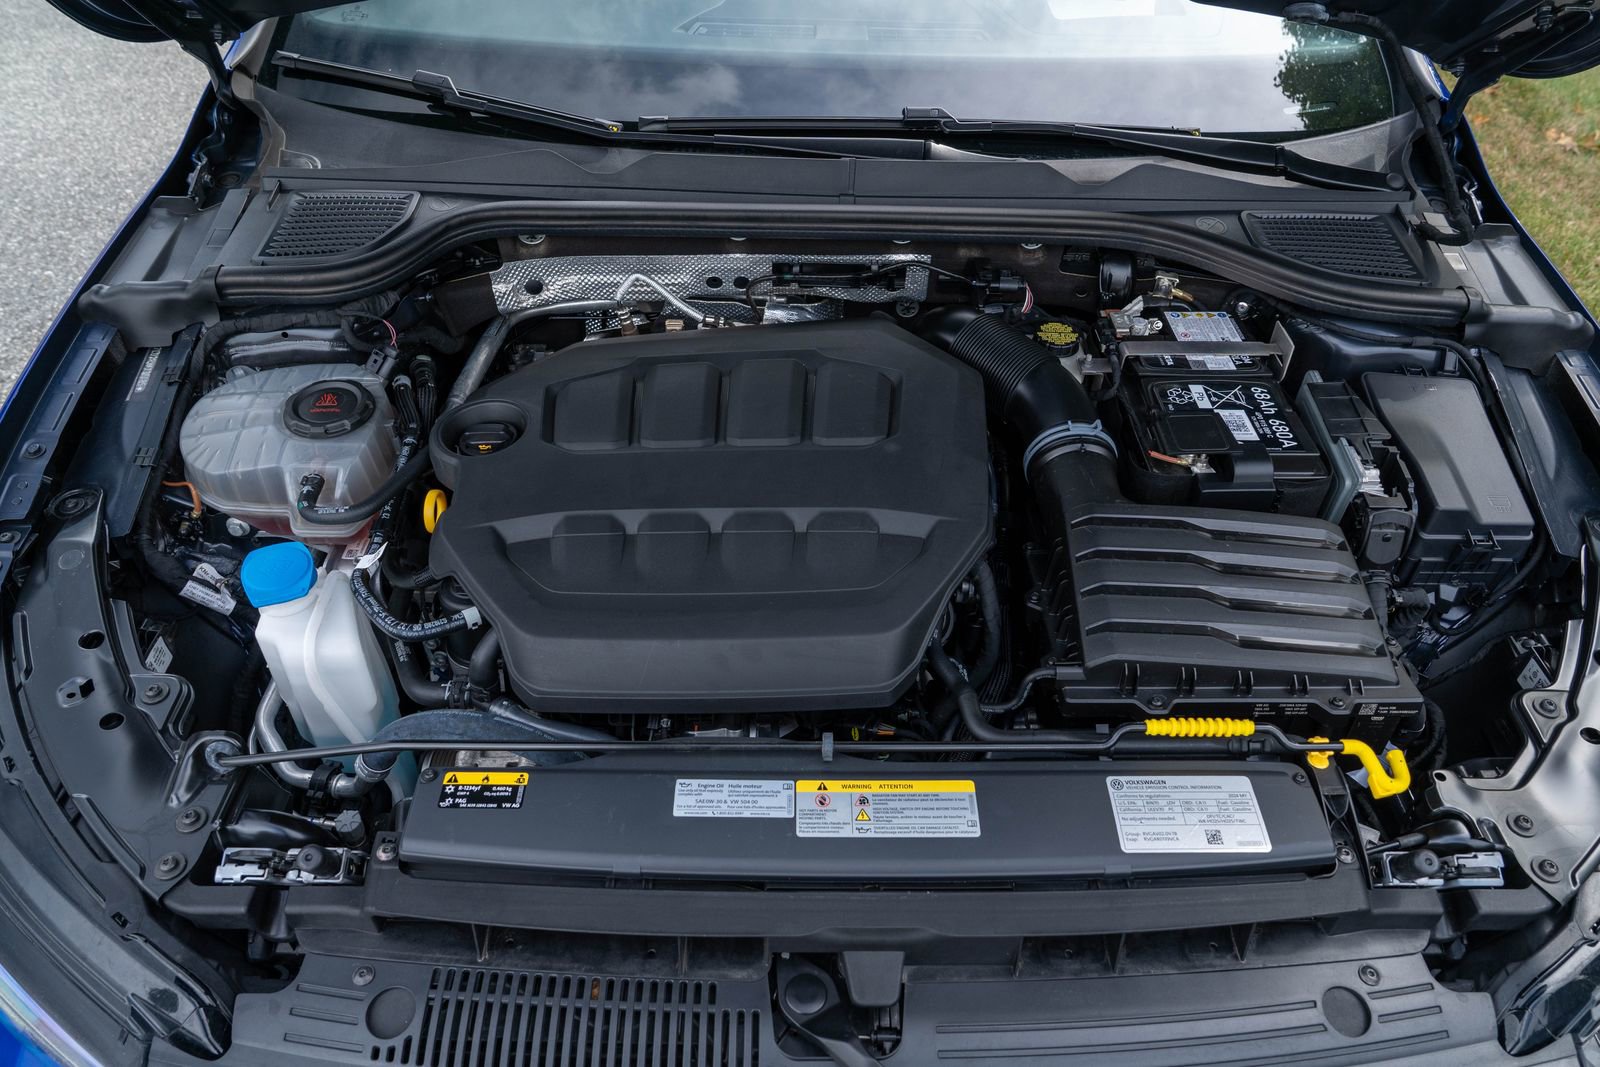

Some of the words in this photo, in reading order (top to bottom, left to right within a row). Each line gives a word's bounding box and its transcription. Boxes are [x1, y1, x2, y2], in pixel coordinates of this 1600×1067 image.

[1194, 392, 1204, 401] Pb
[1250, 387, 1278, 414] 68Ah
[1268, 419, 1298, 448] 680A
